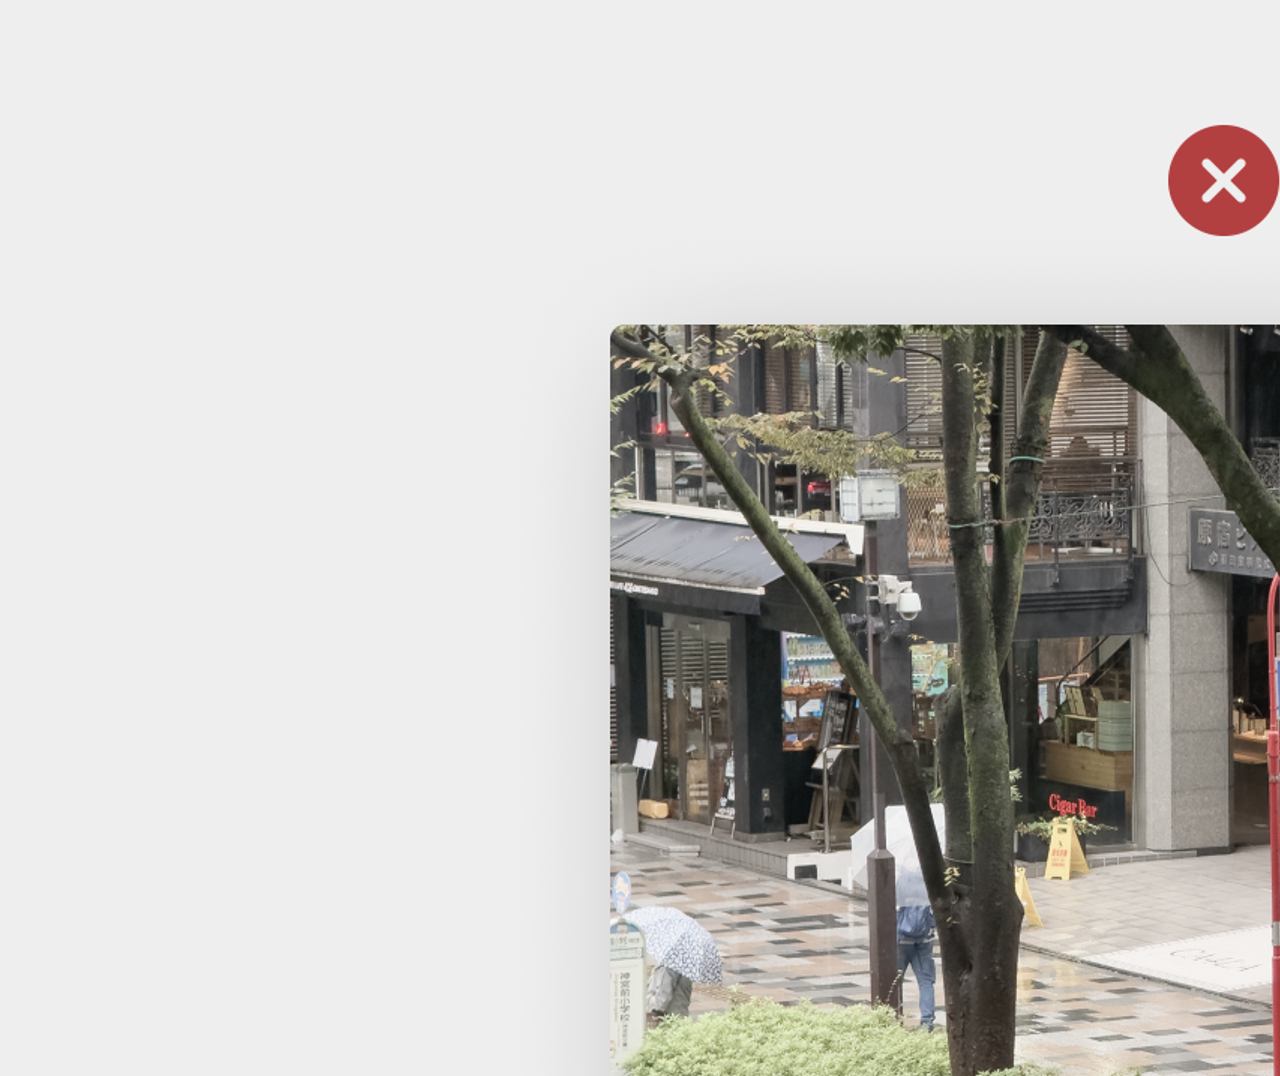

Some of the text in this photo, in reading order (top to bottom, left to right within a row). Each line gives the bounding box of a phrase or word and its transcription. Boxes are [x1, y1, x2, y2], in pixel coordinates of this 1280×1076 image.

[1197, 518, 1258, 551] 原宿ビ
[1048, 793, 1098, 818] Cigar Bar
